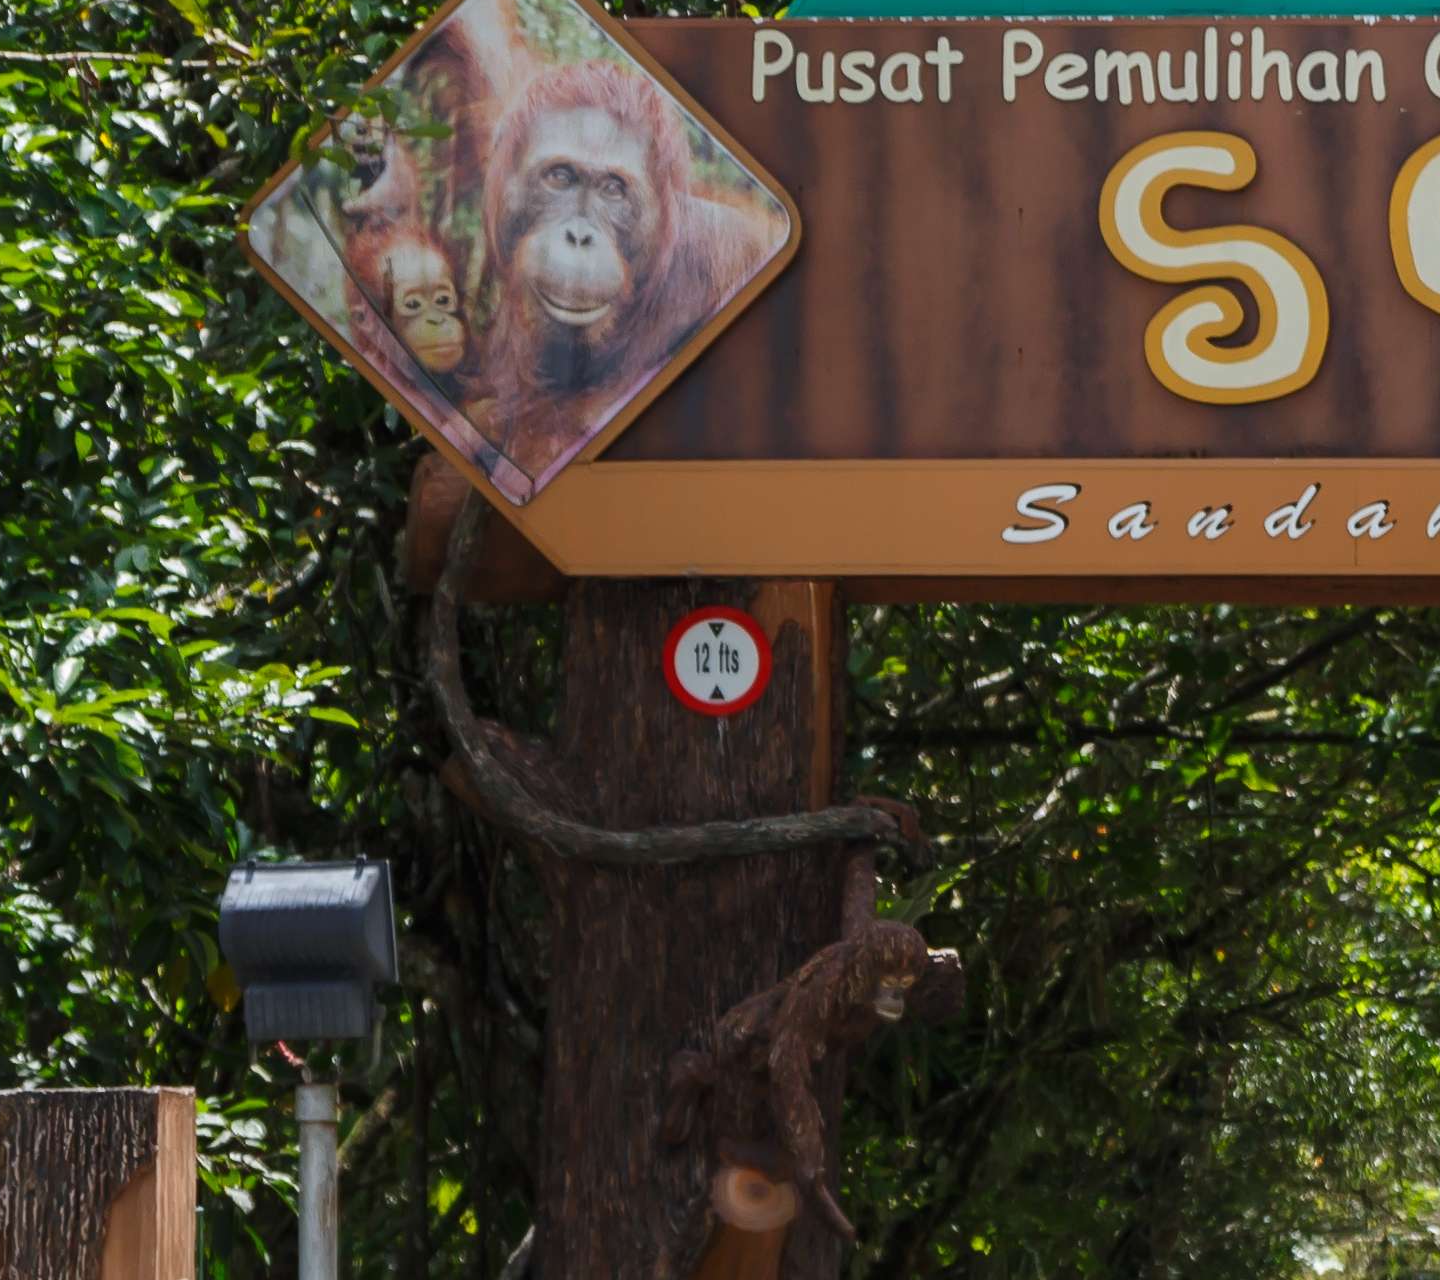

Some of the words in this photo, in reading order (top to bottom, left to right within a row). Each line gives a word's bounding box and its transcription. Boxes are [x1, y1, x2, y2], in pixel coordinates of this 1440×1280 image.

[750, 28, 963, 106] Pusat
[1001, 26, 1385, 108] Pemulihan
[694, 642, 710, 673] 12
[718, 642, 739, 673] fts
